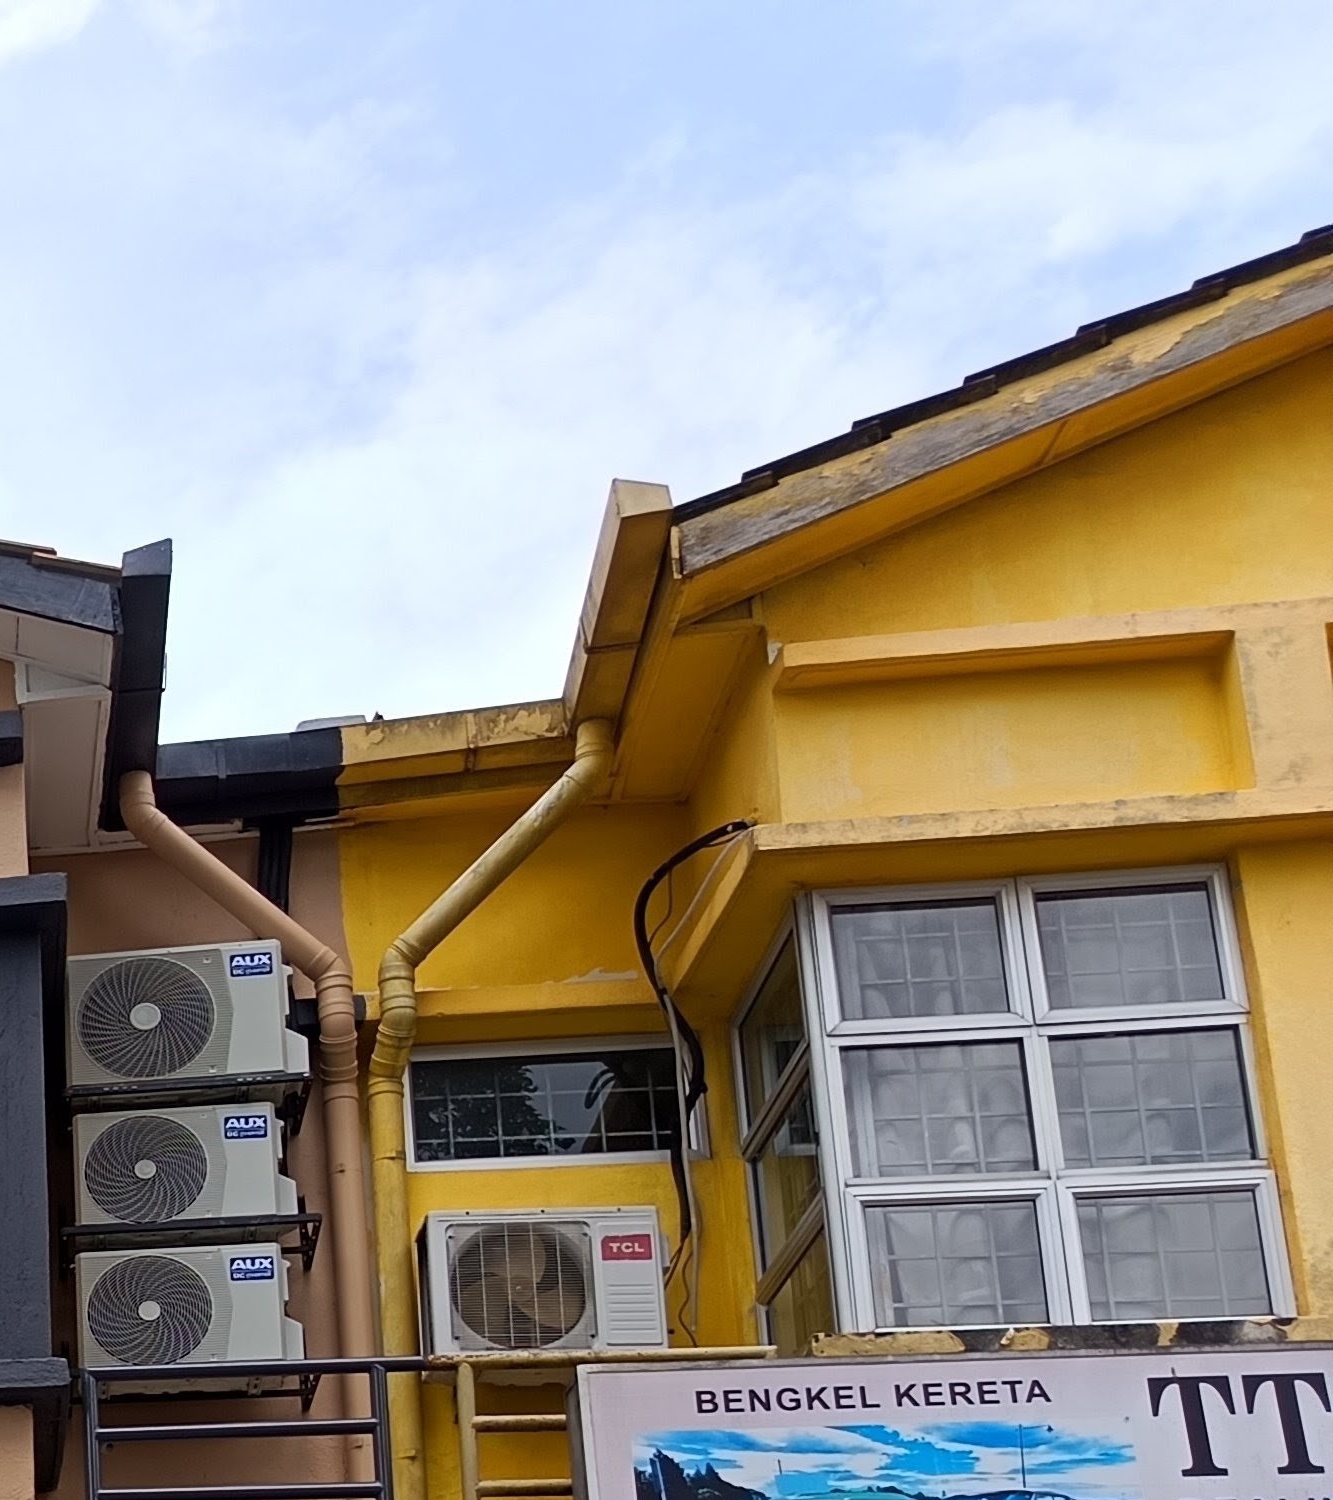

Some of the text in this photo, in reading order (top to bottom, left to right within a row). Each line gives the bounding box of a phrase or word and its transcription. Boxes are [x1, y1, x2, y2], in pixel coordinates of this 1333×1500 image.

[231, 953, 272, 967] AUX
[225, 1117, 266, 1129] AUX
[608, 1242, 645, 1253] TCL
[231, 1257, 273, 1270] AUX
[694, 1379, 1053, 1415] BENGKEL KERETA
